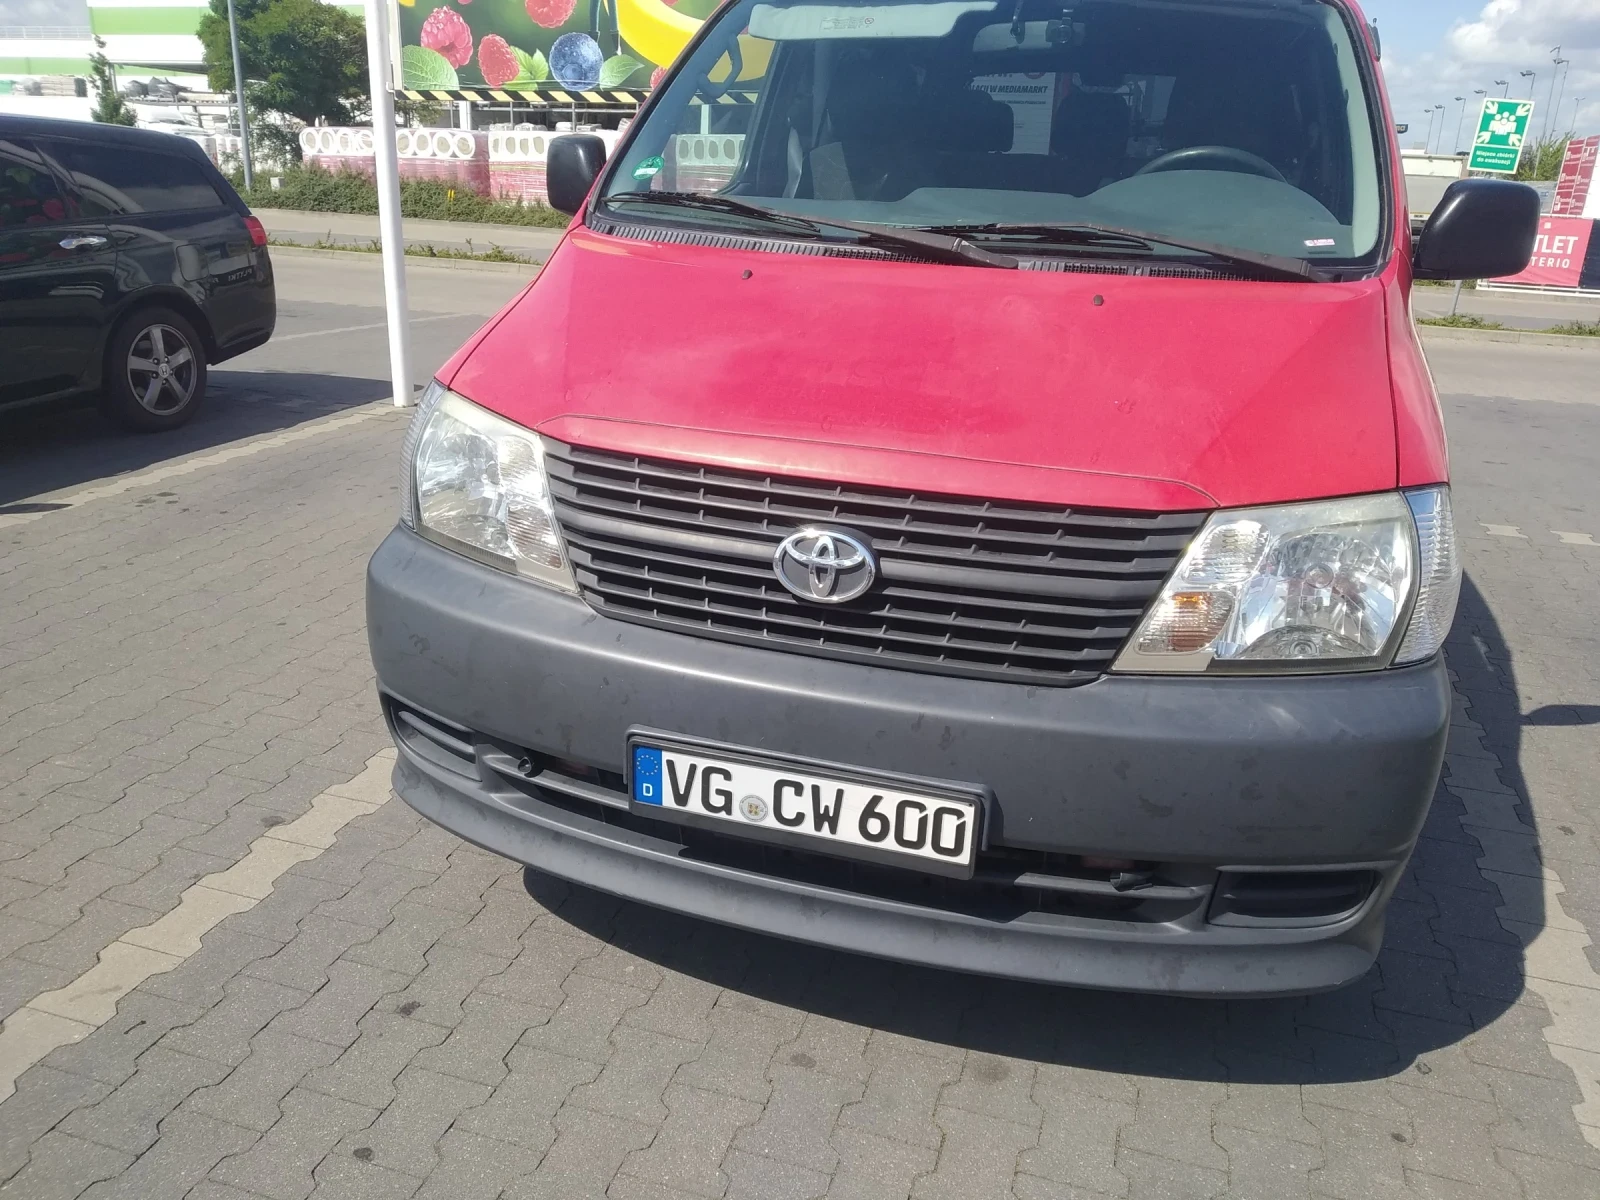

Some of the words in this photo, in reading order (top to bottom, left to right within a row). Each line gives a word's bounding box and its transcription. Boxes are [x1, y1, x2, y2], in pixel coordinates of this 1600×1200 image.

[990, 85, 998, 93] W
[998, 85, 1048, 94] MEDIAMARKT
[1485, 158, 1512, 166] ewakuacji
[642, 783, 653, 797] D
[665, 758, 733, 816] VG
[772, 778, 845, 835] CW
[858, 794, 967, 858] 600
